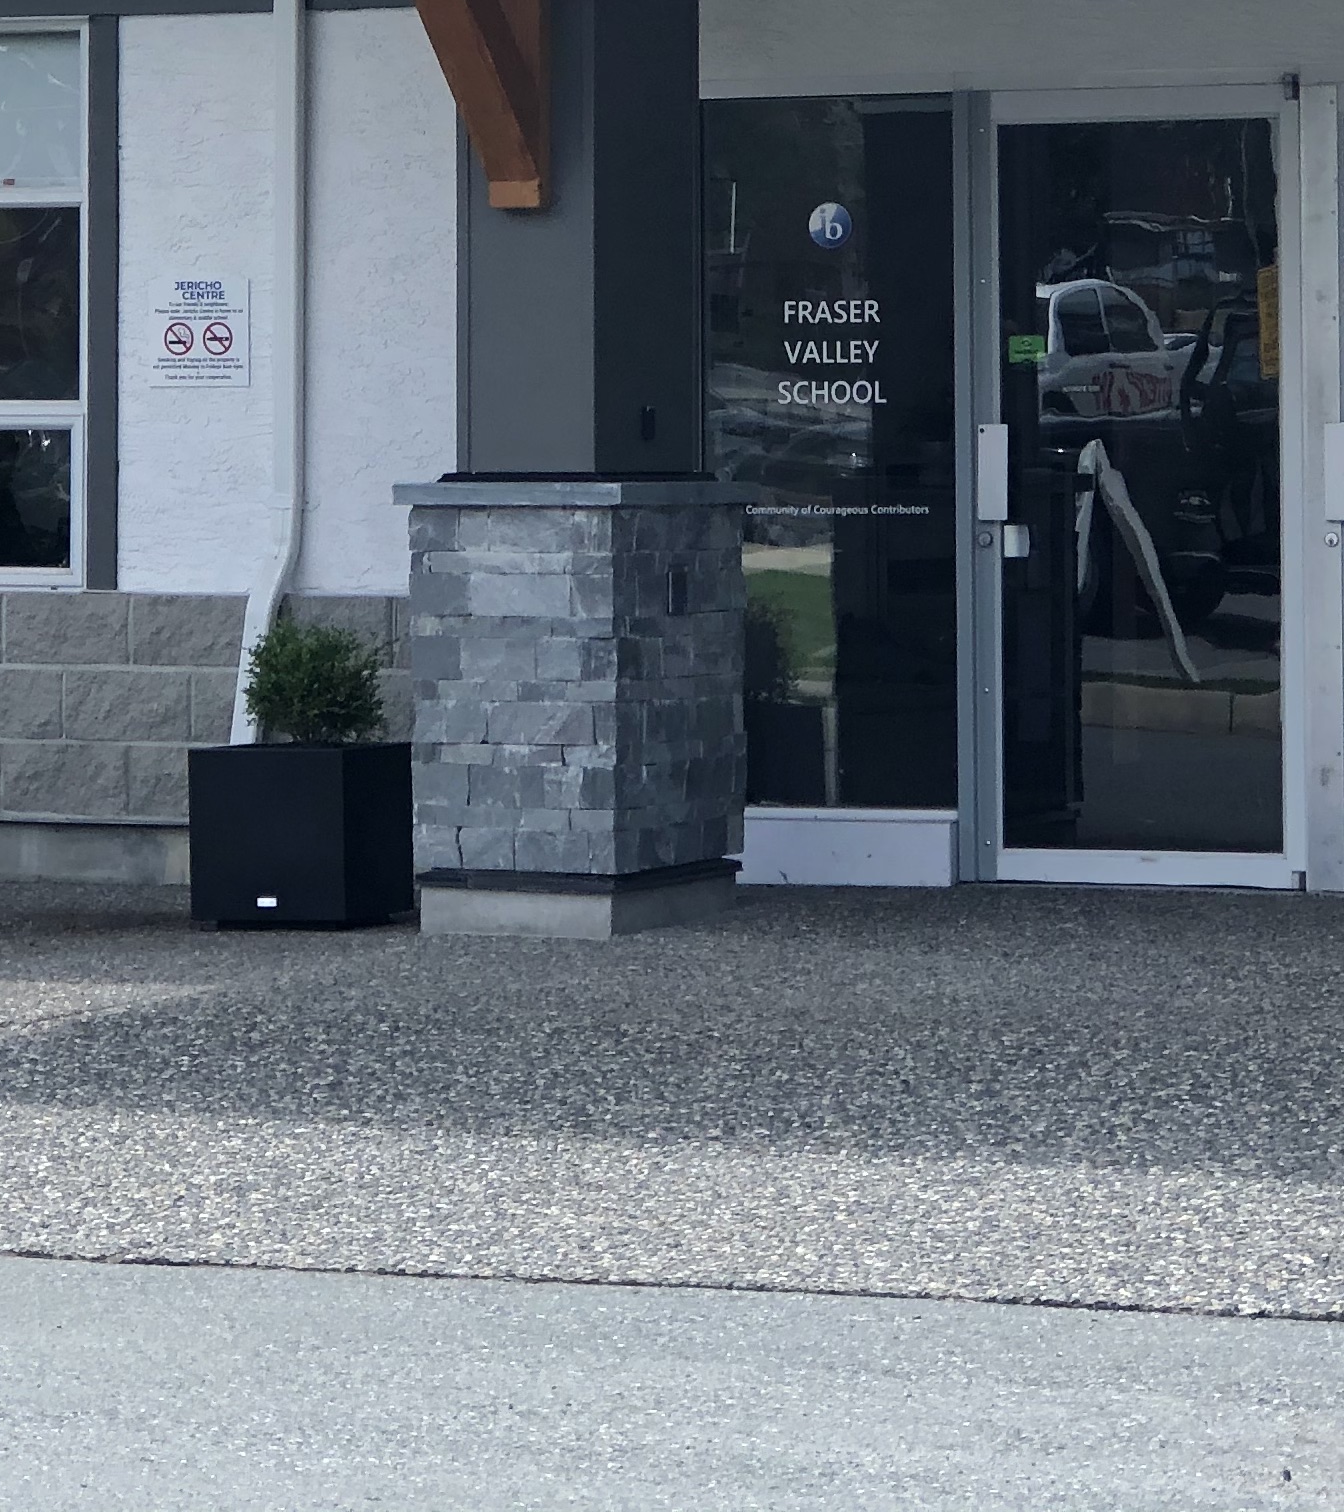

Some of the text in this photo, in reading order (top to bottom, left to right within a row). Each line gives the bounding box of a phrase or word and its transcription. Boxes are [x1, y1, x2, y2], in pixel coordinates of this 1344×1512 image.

[174, 281, 222, 291] JERICHO
[182, 291, 226, 300] CENTRE
[783, 299, 881, 324] FRASER
[783, 340, 880, 364] VALLEY
[777, 380, 887, 405] SCHOOL
[745, 504, 930, 517] Community of Courageous Contributors
